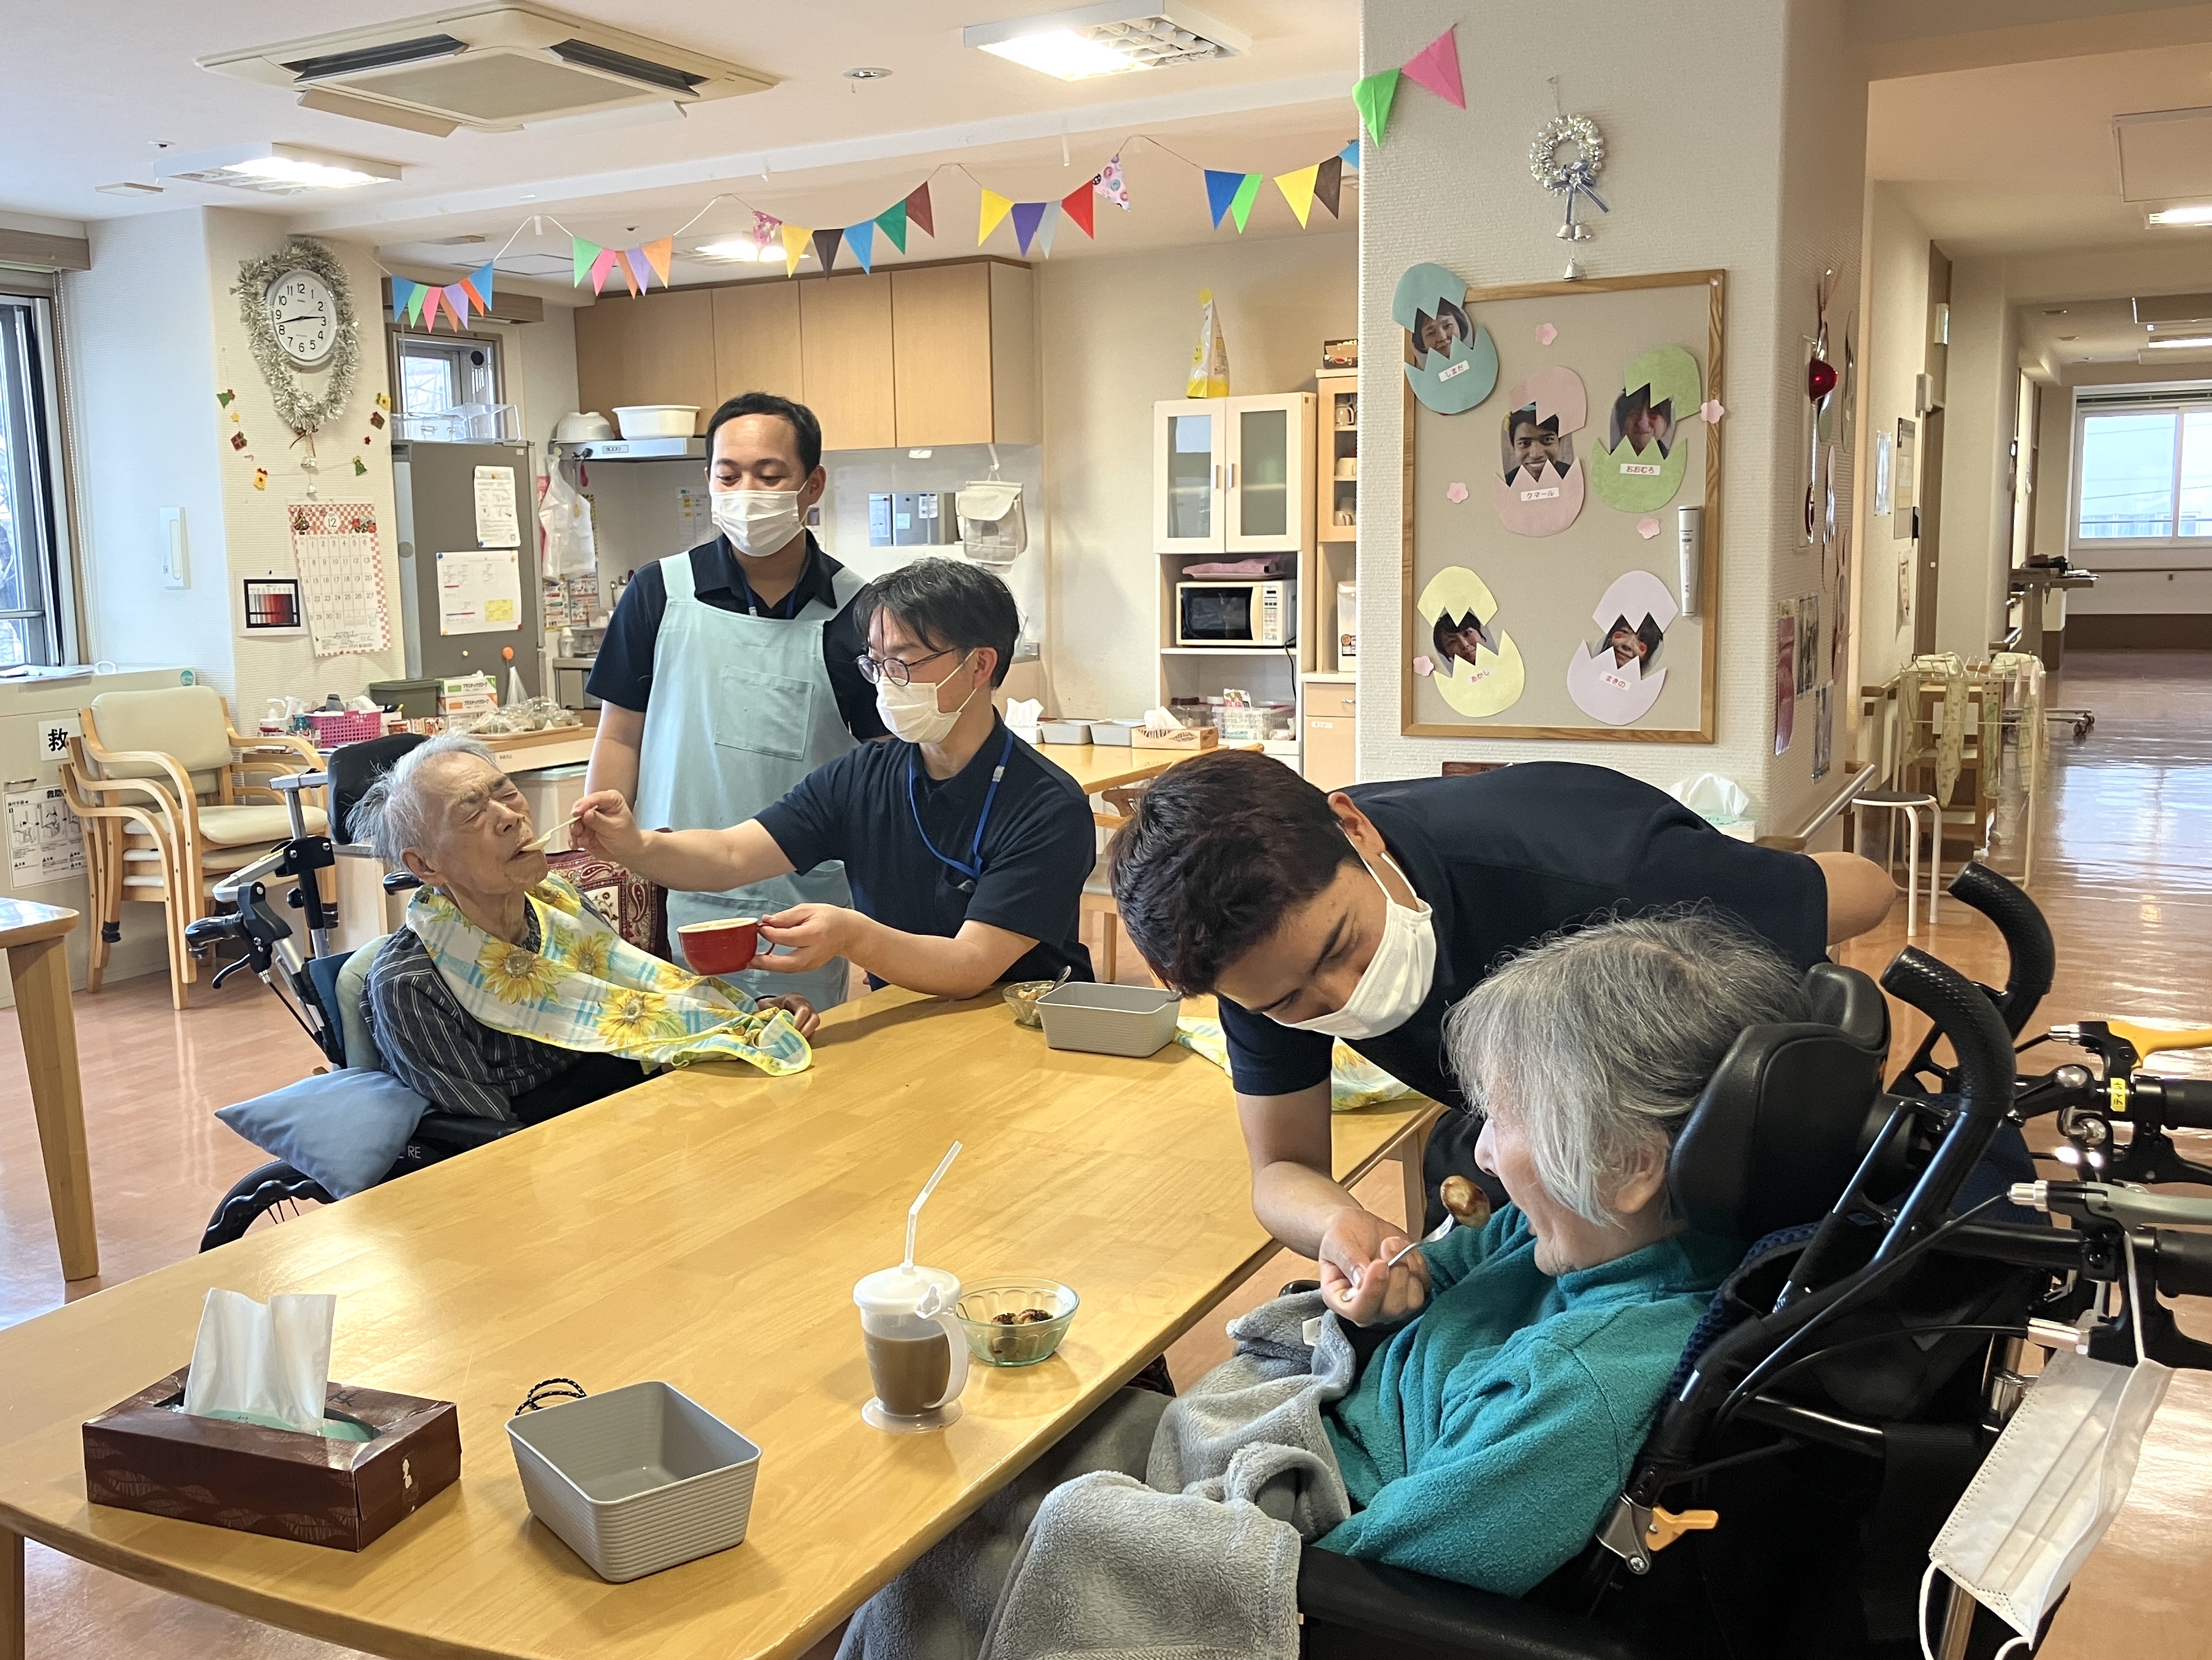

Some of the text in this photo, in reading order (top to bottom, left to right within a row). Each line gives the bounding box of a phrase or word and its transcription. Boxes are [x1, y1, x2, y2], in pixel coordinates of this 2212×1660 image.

[287, 285, 293, 296] 11
[297, 283, 306, 294] 12
[311, 289, 314, 300] 1
[278, 295, 287, 306] 10
[317, 301, 323, 311] 2
[276, 309, 282, 319] 9
[320, 316, 327, 326] 3
[279, 325, 285, 335] 8
[317, 330, 323, 340] 4
[287, 337, 293, 347] 7
[298, 342, 304, 352] 6
[309, 340, 316, 350] 5
[1445, 363, 1464, 378] しまだ
[1526, 490, 1555, 499] クマール
[328, 518, 337, 528] 12
[1606, 675, 1626, 688] まきの
